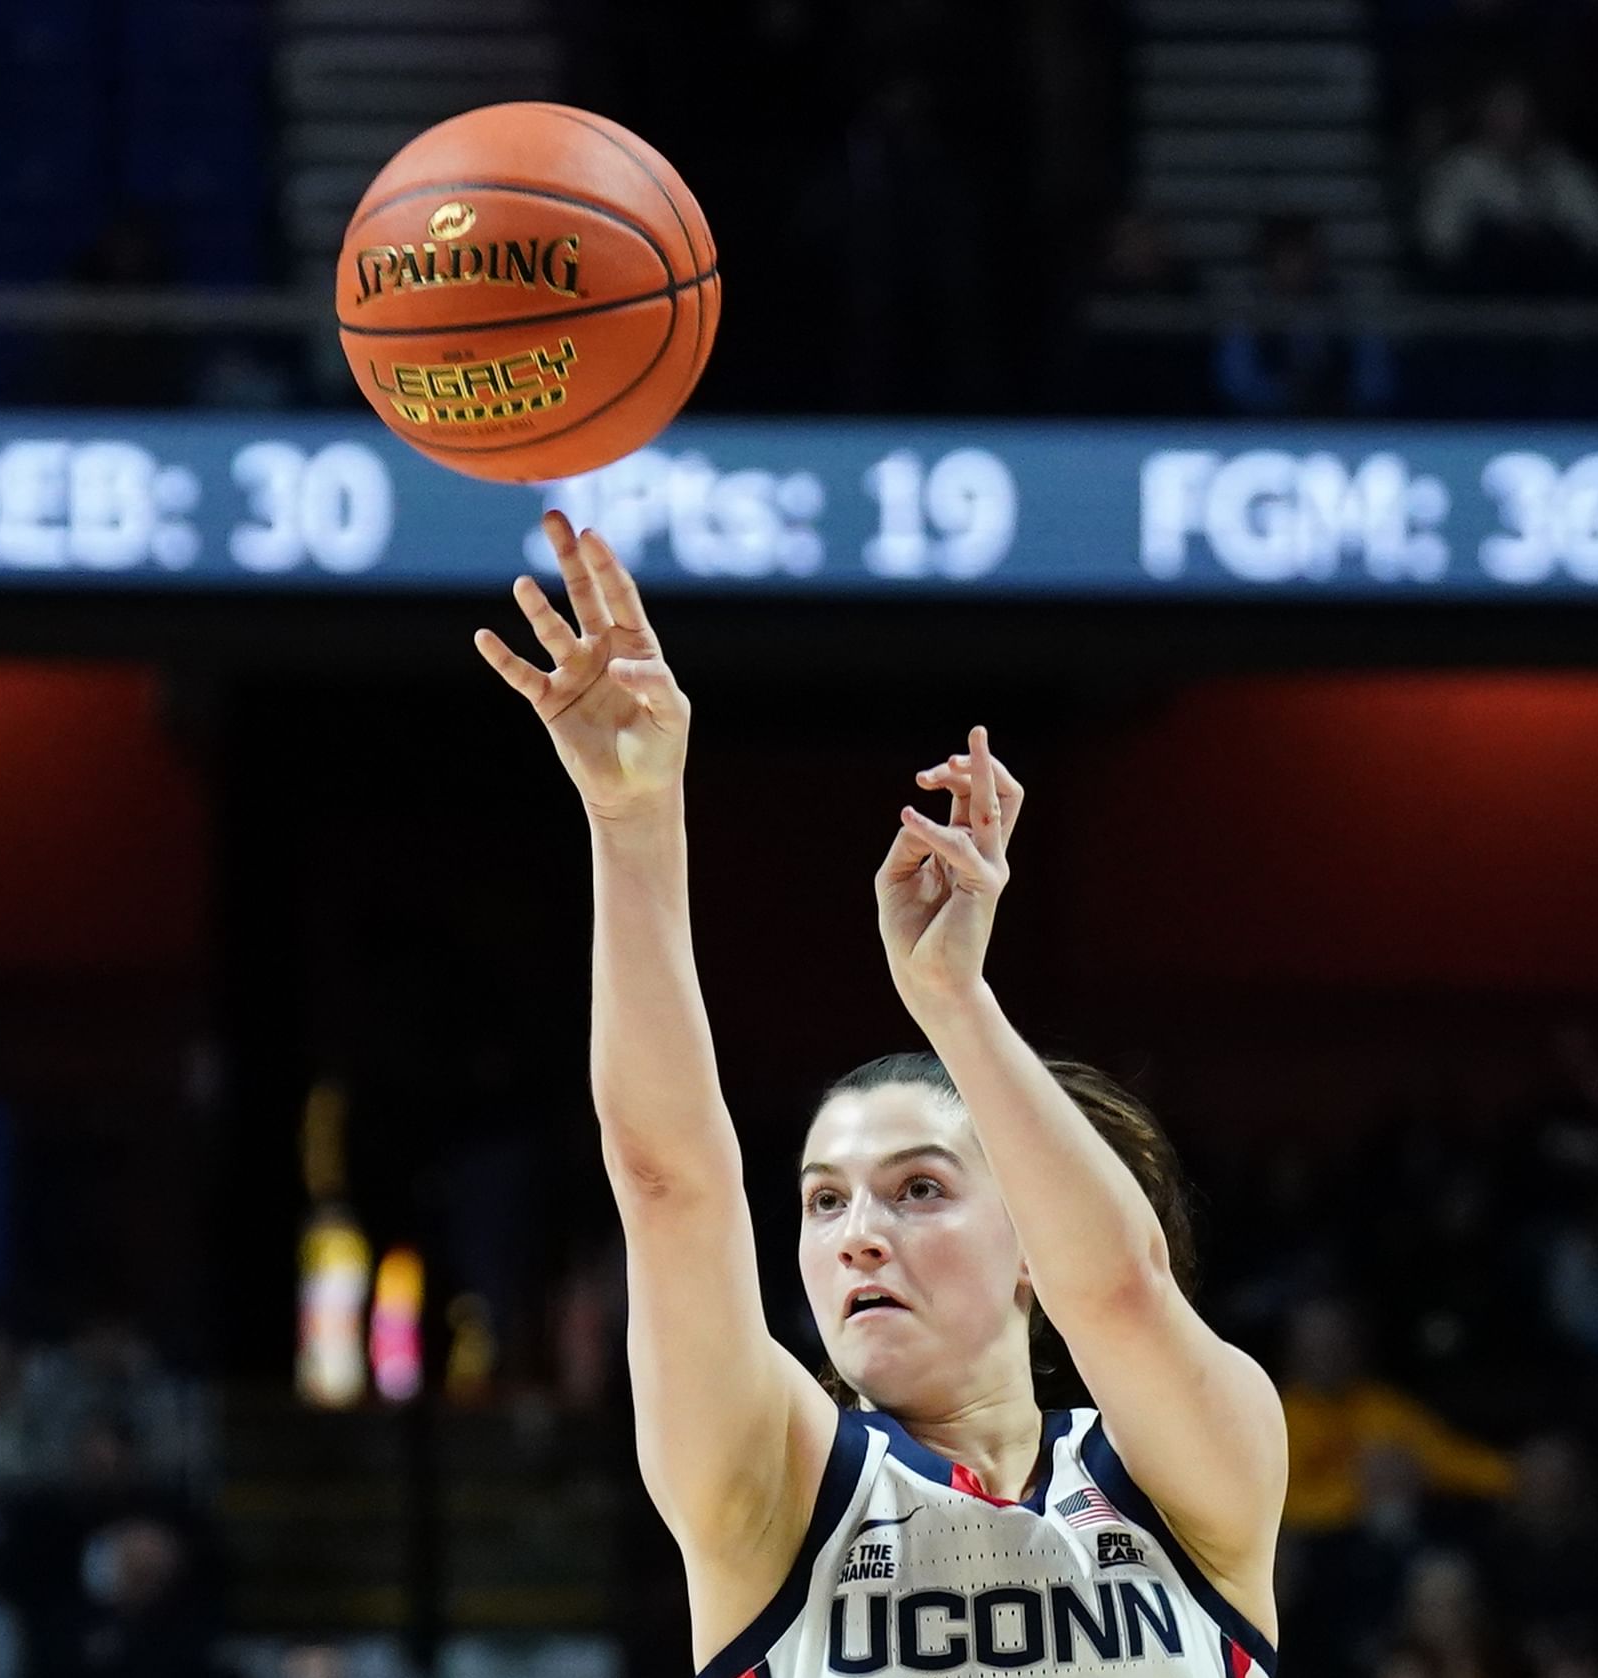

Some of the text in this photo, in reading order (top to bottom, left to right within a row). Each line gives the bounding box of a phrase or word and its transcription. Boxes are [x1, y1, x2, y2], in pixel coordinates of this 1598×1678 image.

[356, 233, 581, 307] SPALDING
[369, 336, 578, 401] LEGACY
[230, 440, 393, 573] 30
[864, 448, 1017, 580] 19
[1140, 450, 1450, 584] FGM:
[859, 1543, 894, 1561] THE
[1097, 1532, 1133, 1547] BIG
[1097, 1546, 1145, 1562] EAST
[840, 1561, 895, 1584] HANGE
[827, 1578, 1186, 1678] UCONN
